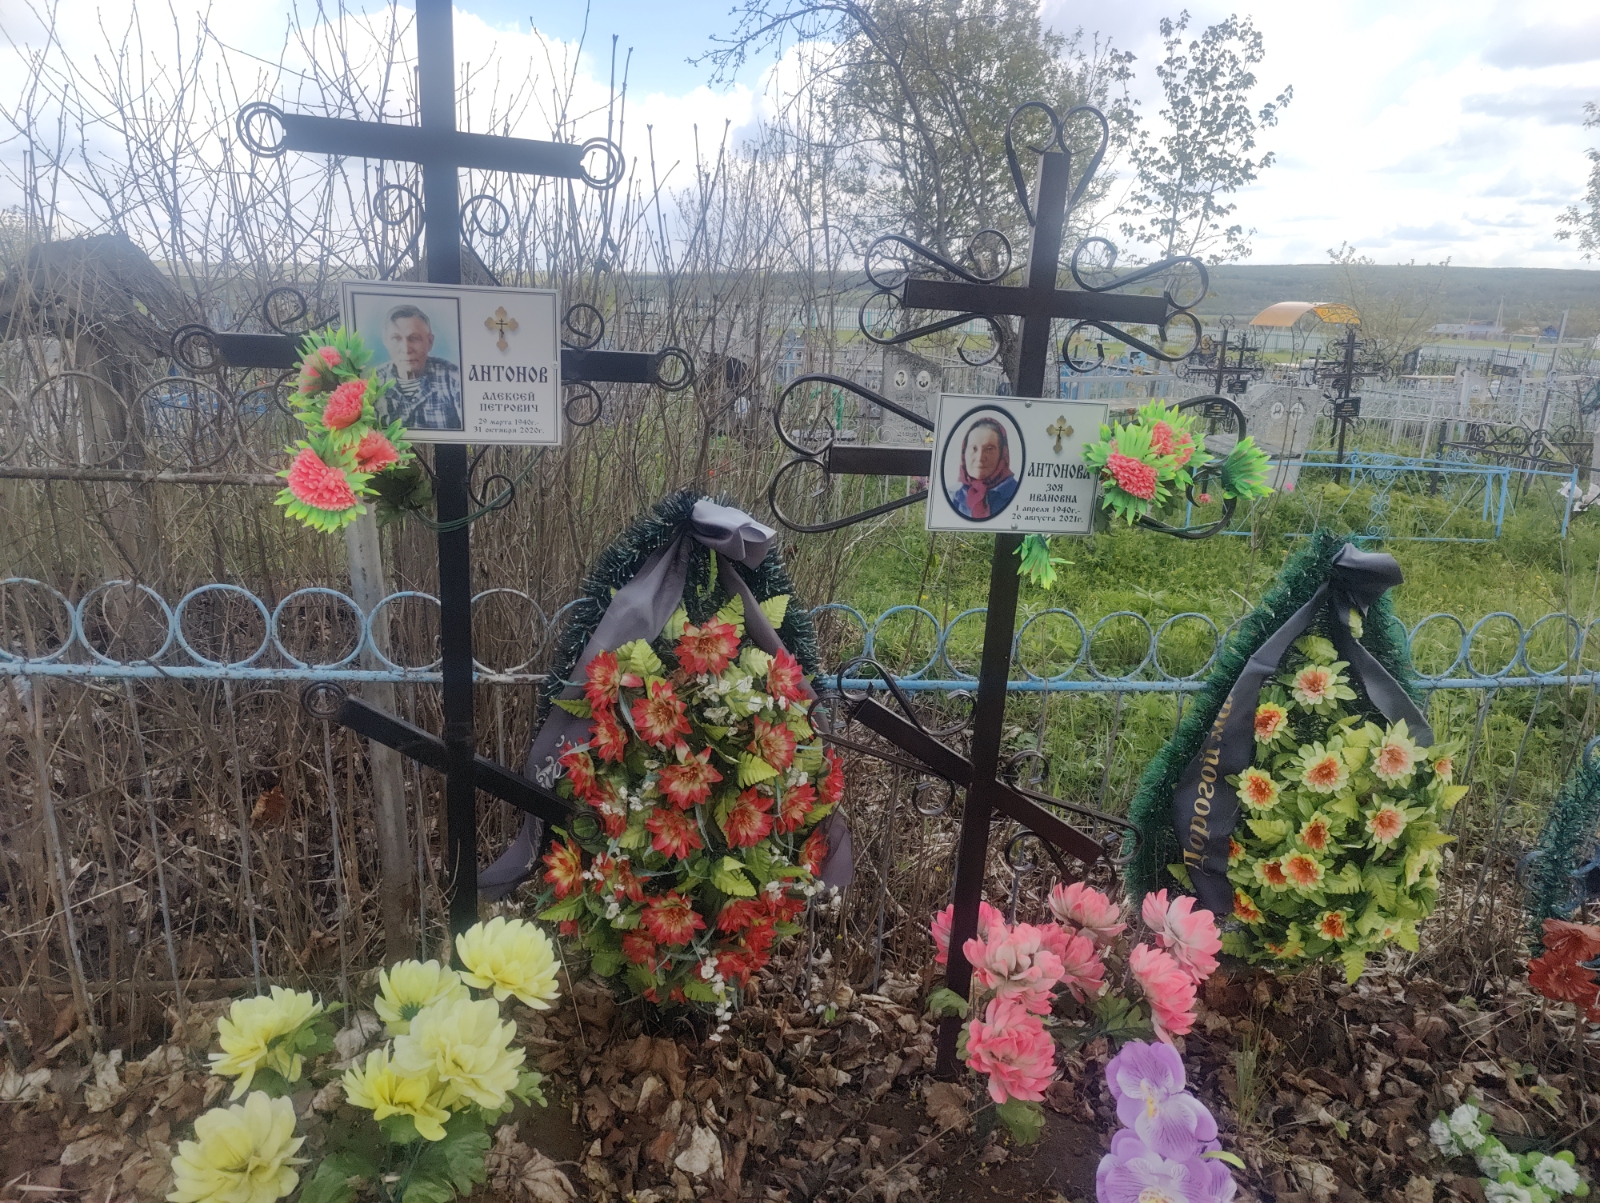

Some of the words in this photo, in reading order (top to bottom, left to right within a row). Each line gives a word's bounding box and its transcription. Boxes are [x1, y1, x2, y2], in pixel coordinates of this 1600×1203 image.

[468, 364, 548, 383] АНТОНОВ
[482, 391, 536, 402] АЛЕКСЕЙ
[479, 403, 539, 413] ПЕТРОВИЧ
[478, 418, 488, 426] 29
[489, 419, 513, 427] марта
[1027, 462, 1091, 480] АНТОНОВА
[1046, 483, 1064, 492] ЗОЯ
[1029, 493, 1078, 503] ИВАНОВНА
[1022, 506, 1050, 514] апреля
[1024, 515, 1056, 523] августа
[1183, 747, 1221, 877] Дорогой
